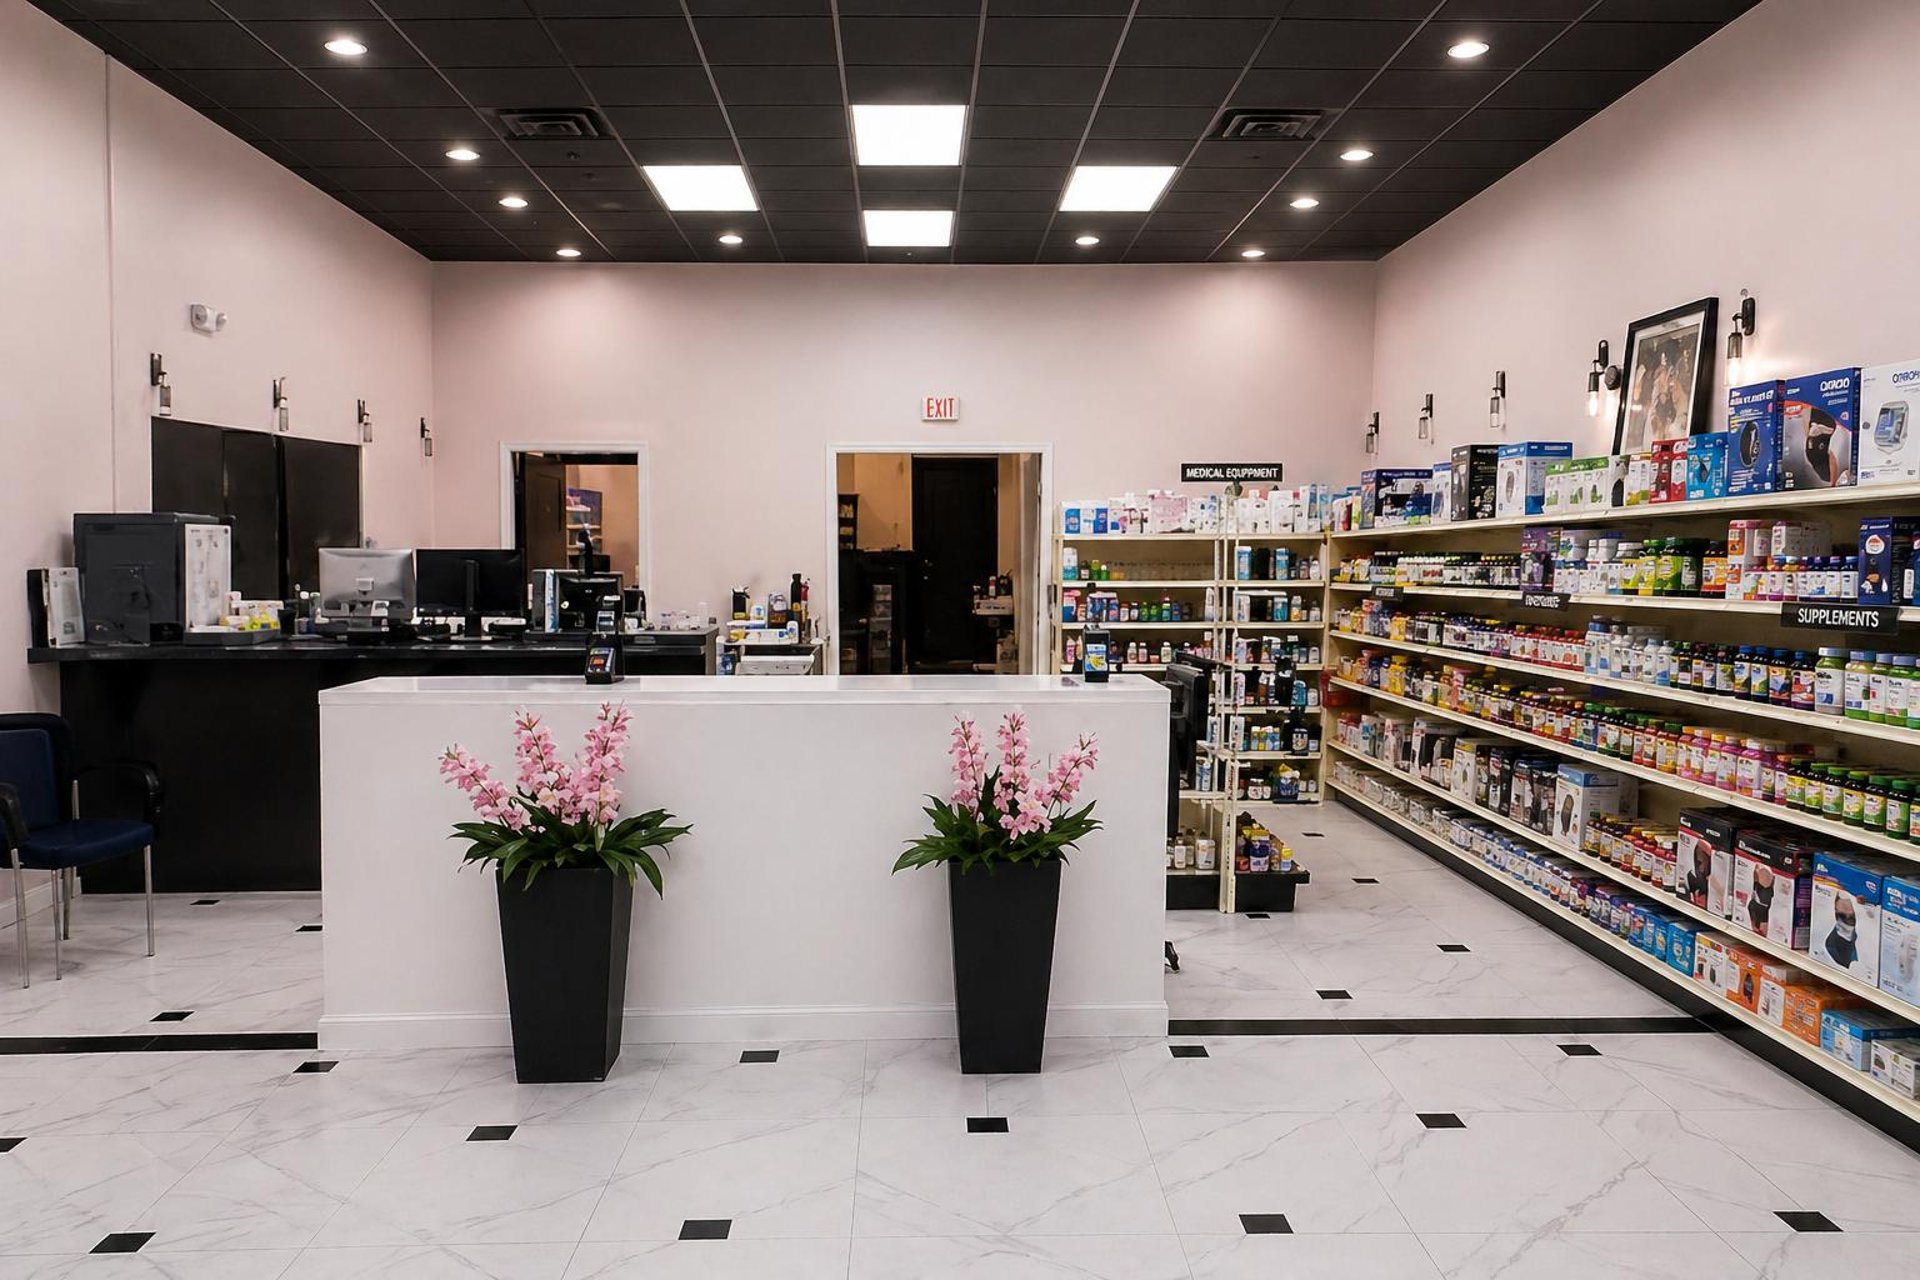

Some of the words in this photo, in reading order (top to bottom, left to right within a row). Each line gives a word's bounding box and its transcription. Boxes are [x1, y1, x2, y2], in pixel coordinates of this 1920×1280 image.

[927, 398, 954, 417] EXIT
[1186, 468, 1224, 478] MEDICAL
[1798, 608, 1879, 627] SUPPLEMENTS
